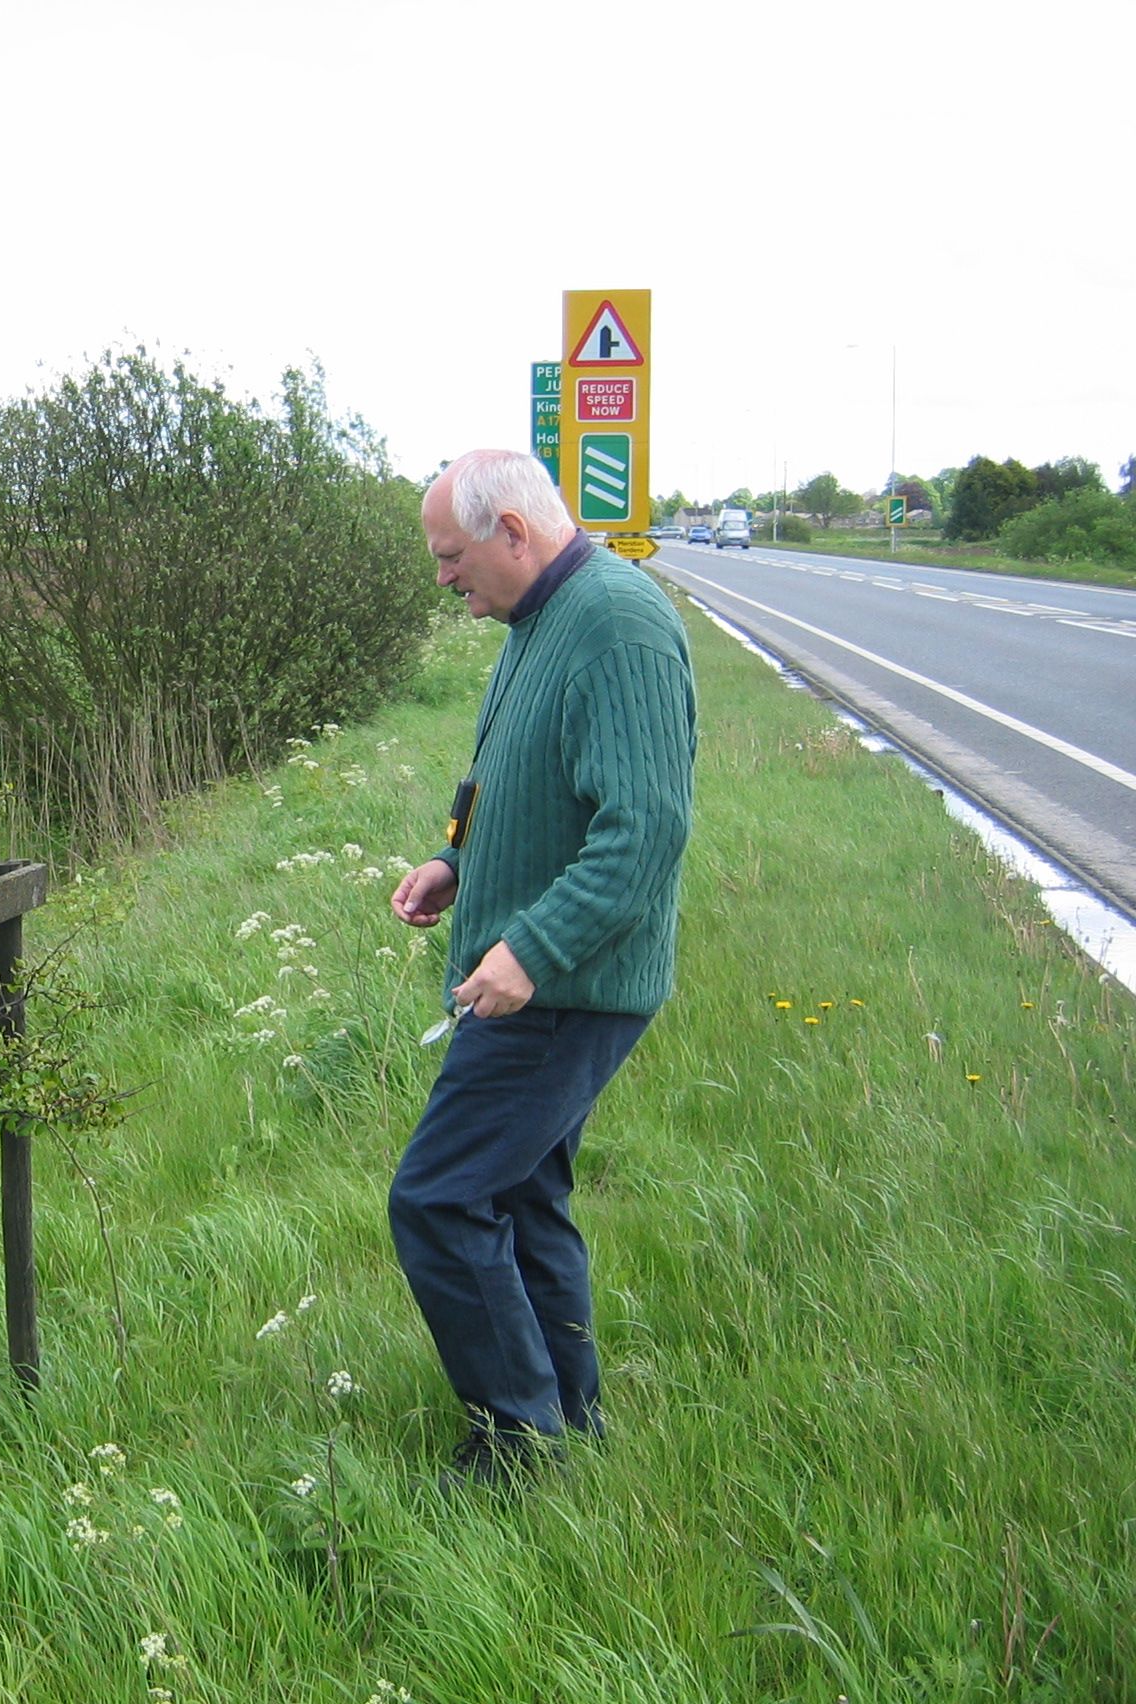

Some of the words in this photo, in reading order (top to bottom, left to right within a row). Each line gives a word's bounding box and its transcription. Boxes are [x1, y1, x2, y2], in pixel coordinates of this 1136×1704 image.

[582, 384, 630, 394] REDUCE
[586, 395, 625, 405] SPEED
[591, 406, 620, 416] NOW
